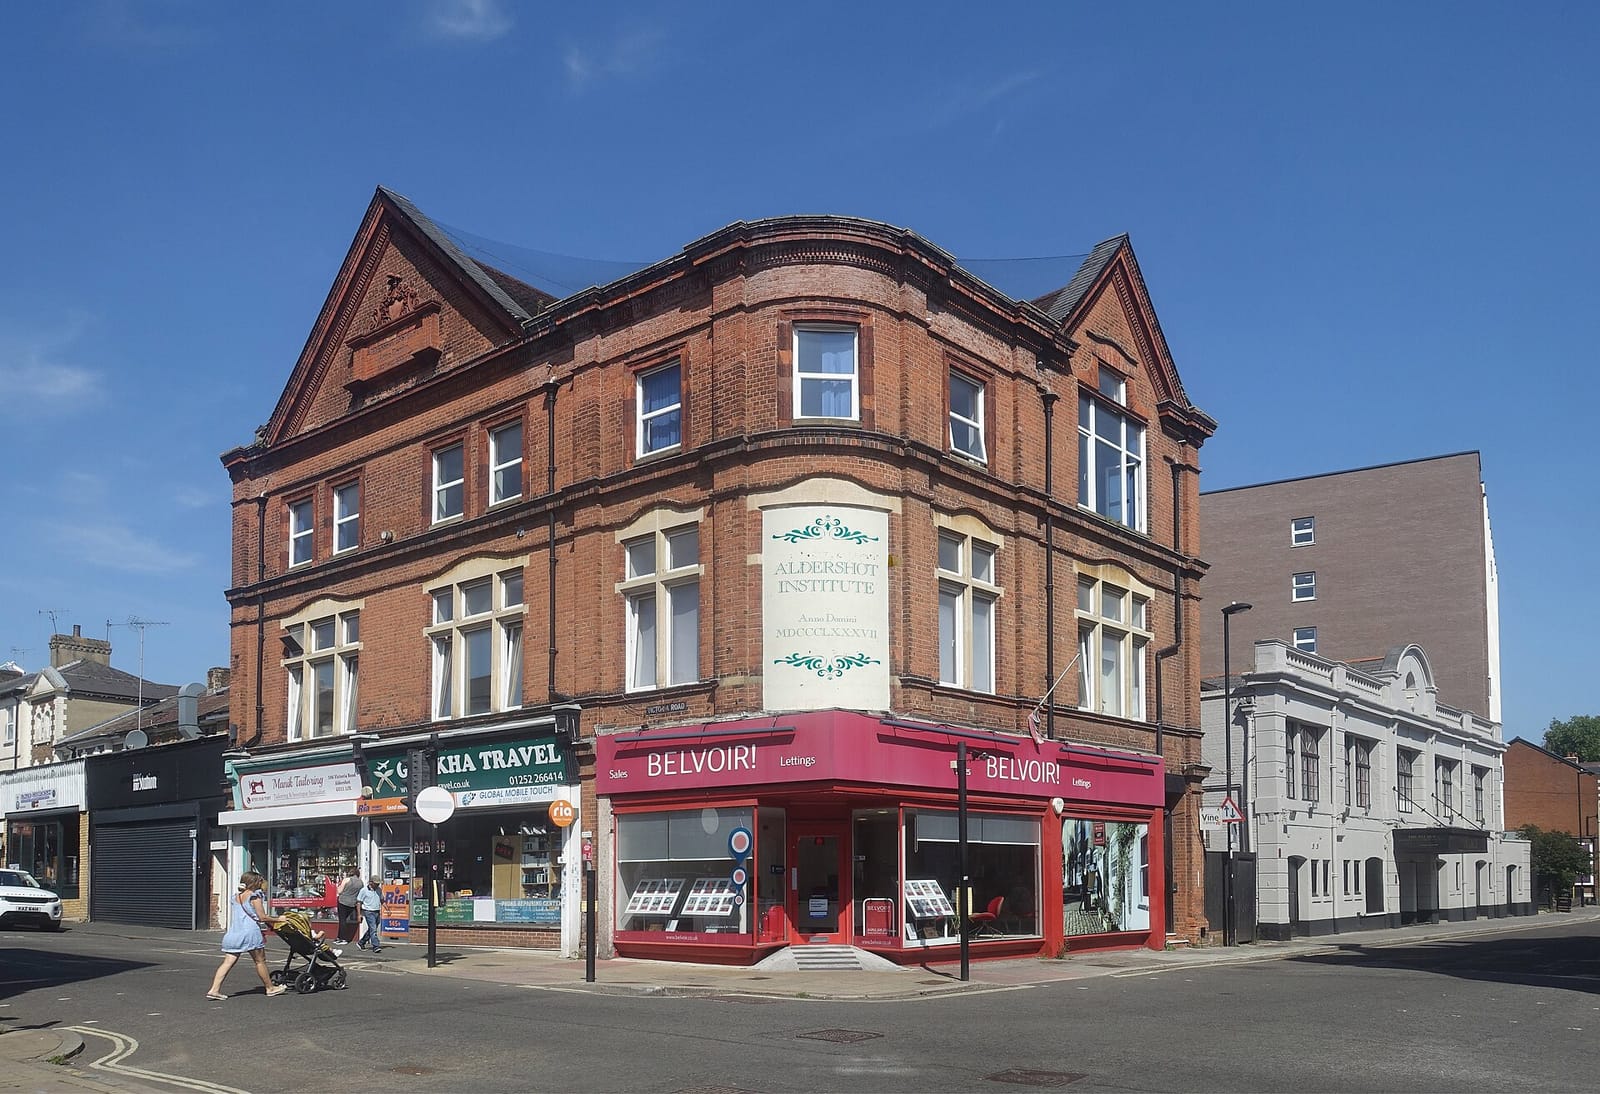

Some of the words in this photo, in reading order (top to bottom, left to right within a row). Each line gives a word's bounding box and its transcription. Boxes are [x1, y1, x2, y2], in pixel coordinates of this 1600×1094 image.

[775, 561, 879, 577] ALDERSHOT
[778, 580, 875, 595] INSTITUTE
[799, 614, 824, 623] Anno
[826, 614, 857, 623] Domini
[776, 627, 877, 639] MDCCCLXXXVII
[670, 703, 685, 711] ROAD
[479, 744, 561, 770] TRAVEL
[609, 769, 628, 779] Sales
[647, 744, 757, 777] BELVOIR!
[780, 755, 816, 767] Lettings
[509, 774, 533, 785] 01252
[534, 771, 563, 784] 266414
[986, 755, 1060, 784] BELVOIR!
[1072, 777, 1092, 789] Lettings
[294, 775, 324, 788] Tailoring
[479, 790, 504, 800] GLOBAL
[505, 788, 529, 798] MOBILE
[530, 786, 553, 796] TOUCH
[553, 802, 572, 817] ria
[1201, 814, 1219, 822] Vine
[385, 887, 406, 905] Ria
